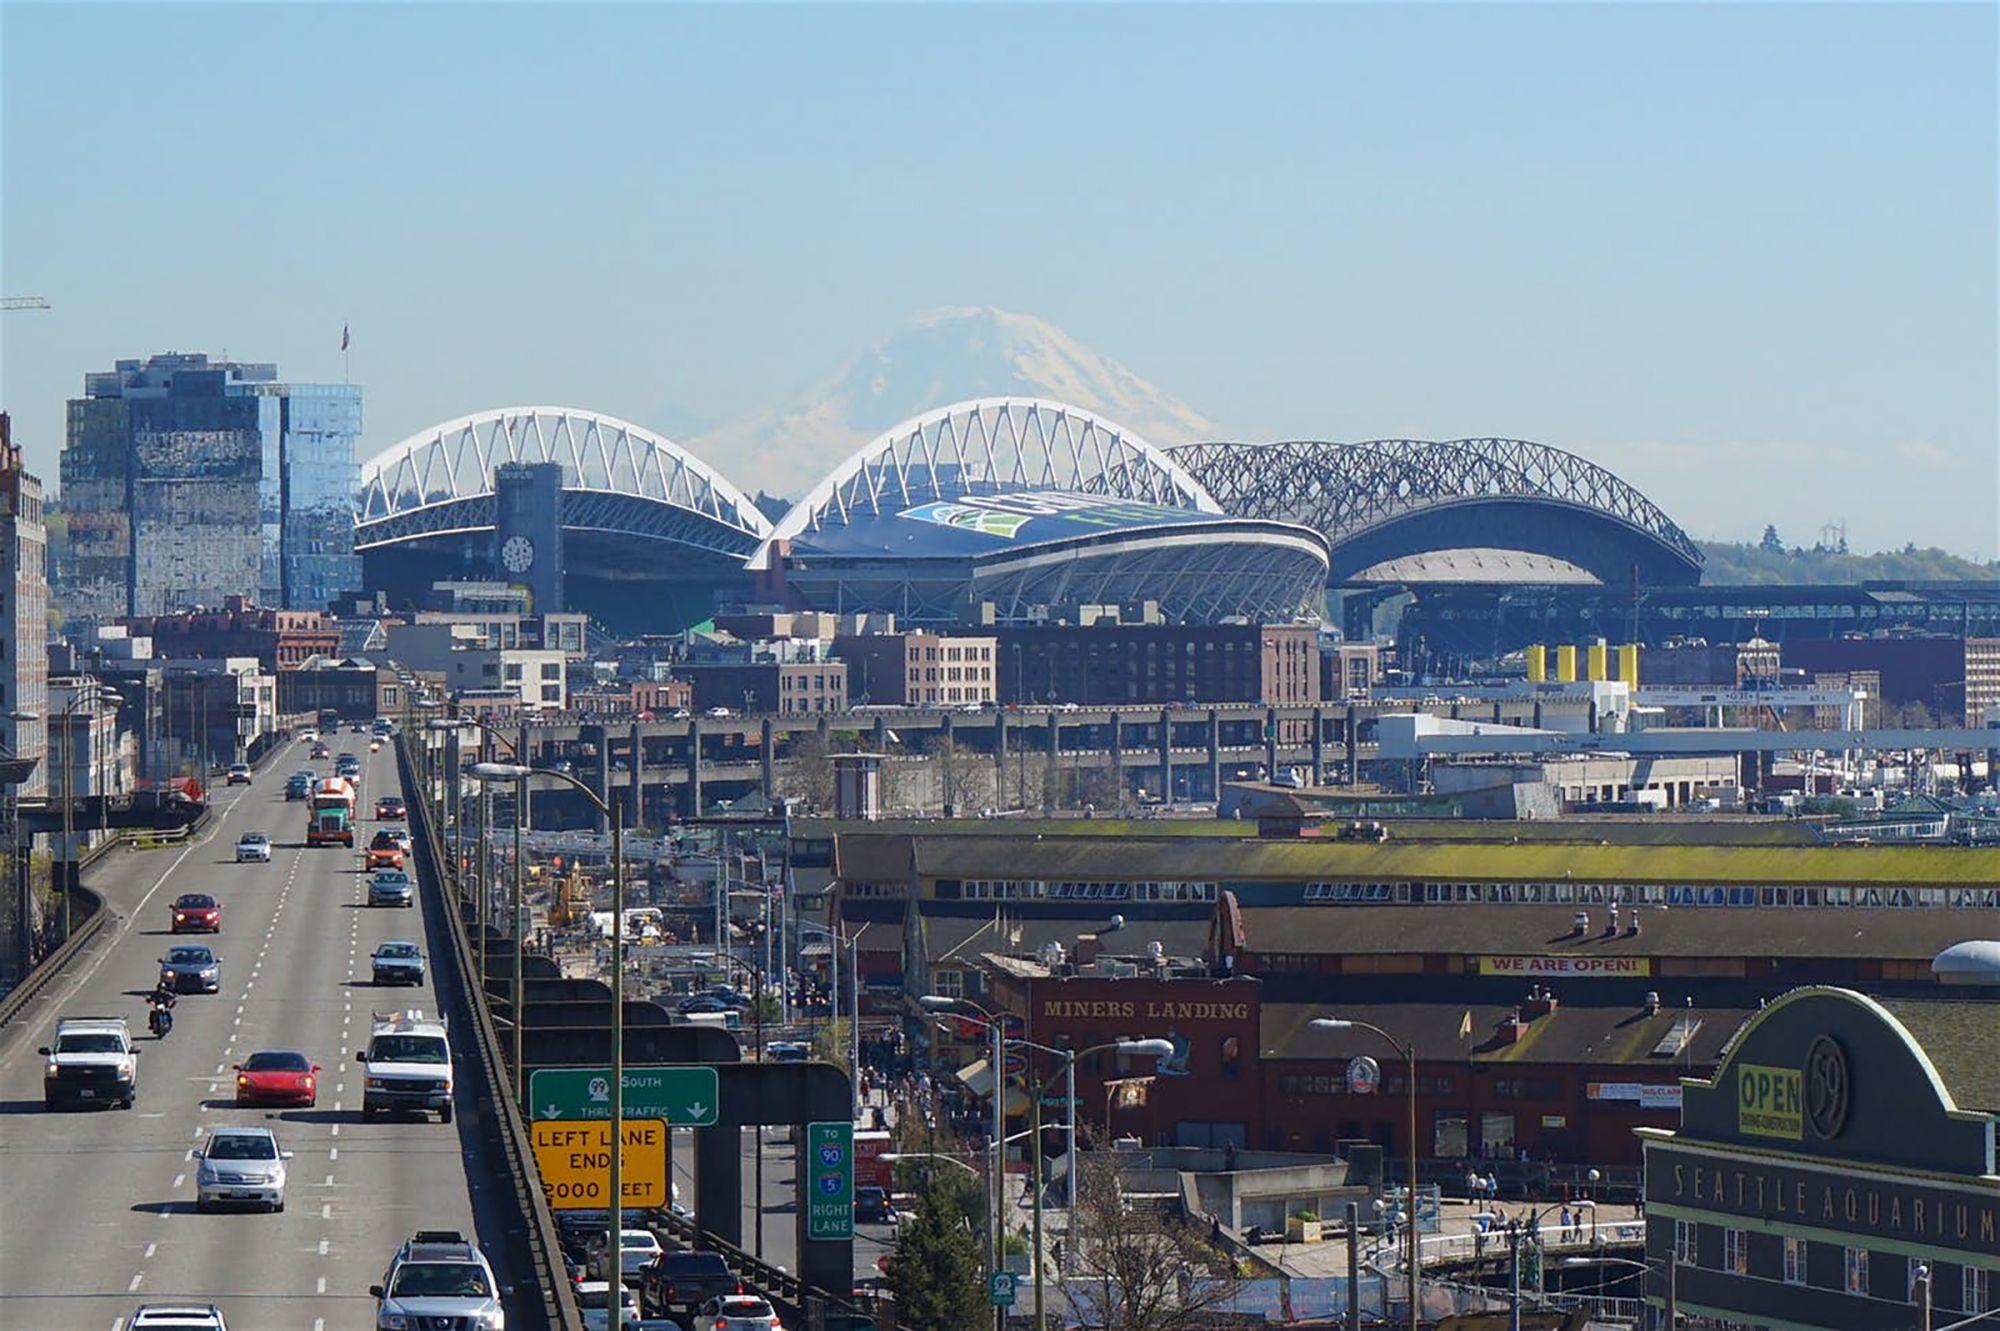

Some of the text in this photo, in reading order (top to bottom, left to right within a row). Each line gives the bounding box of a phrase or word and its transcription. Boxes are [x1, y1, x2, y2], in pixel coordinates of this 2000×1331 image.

[1492, 958, 1639, 972] WE ARE OPEN!
[1044, 1001, 1250, 1020] MINERS LANDING
[1742, 1070, 1801, 1114] OPEN
[538, 1131, 591, 1147] LEFT
[823, 1129, 839, 1139] TO
[822, 1150, 839, 1161] 90
[621, 1183, 653, 1196] EET
[826, 1179, 836, 1192] 5
[1675, 1164, 1996, 1242] SEATTLE AQUARIUM
[812, 1204, 849, 1217] RIGHT
[813, 1220, 849, 1232] LANE
